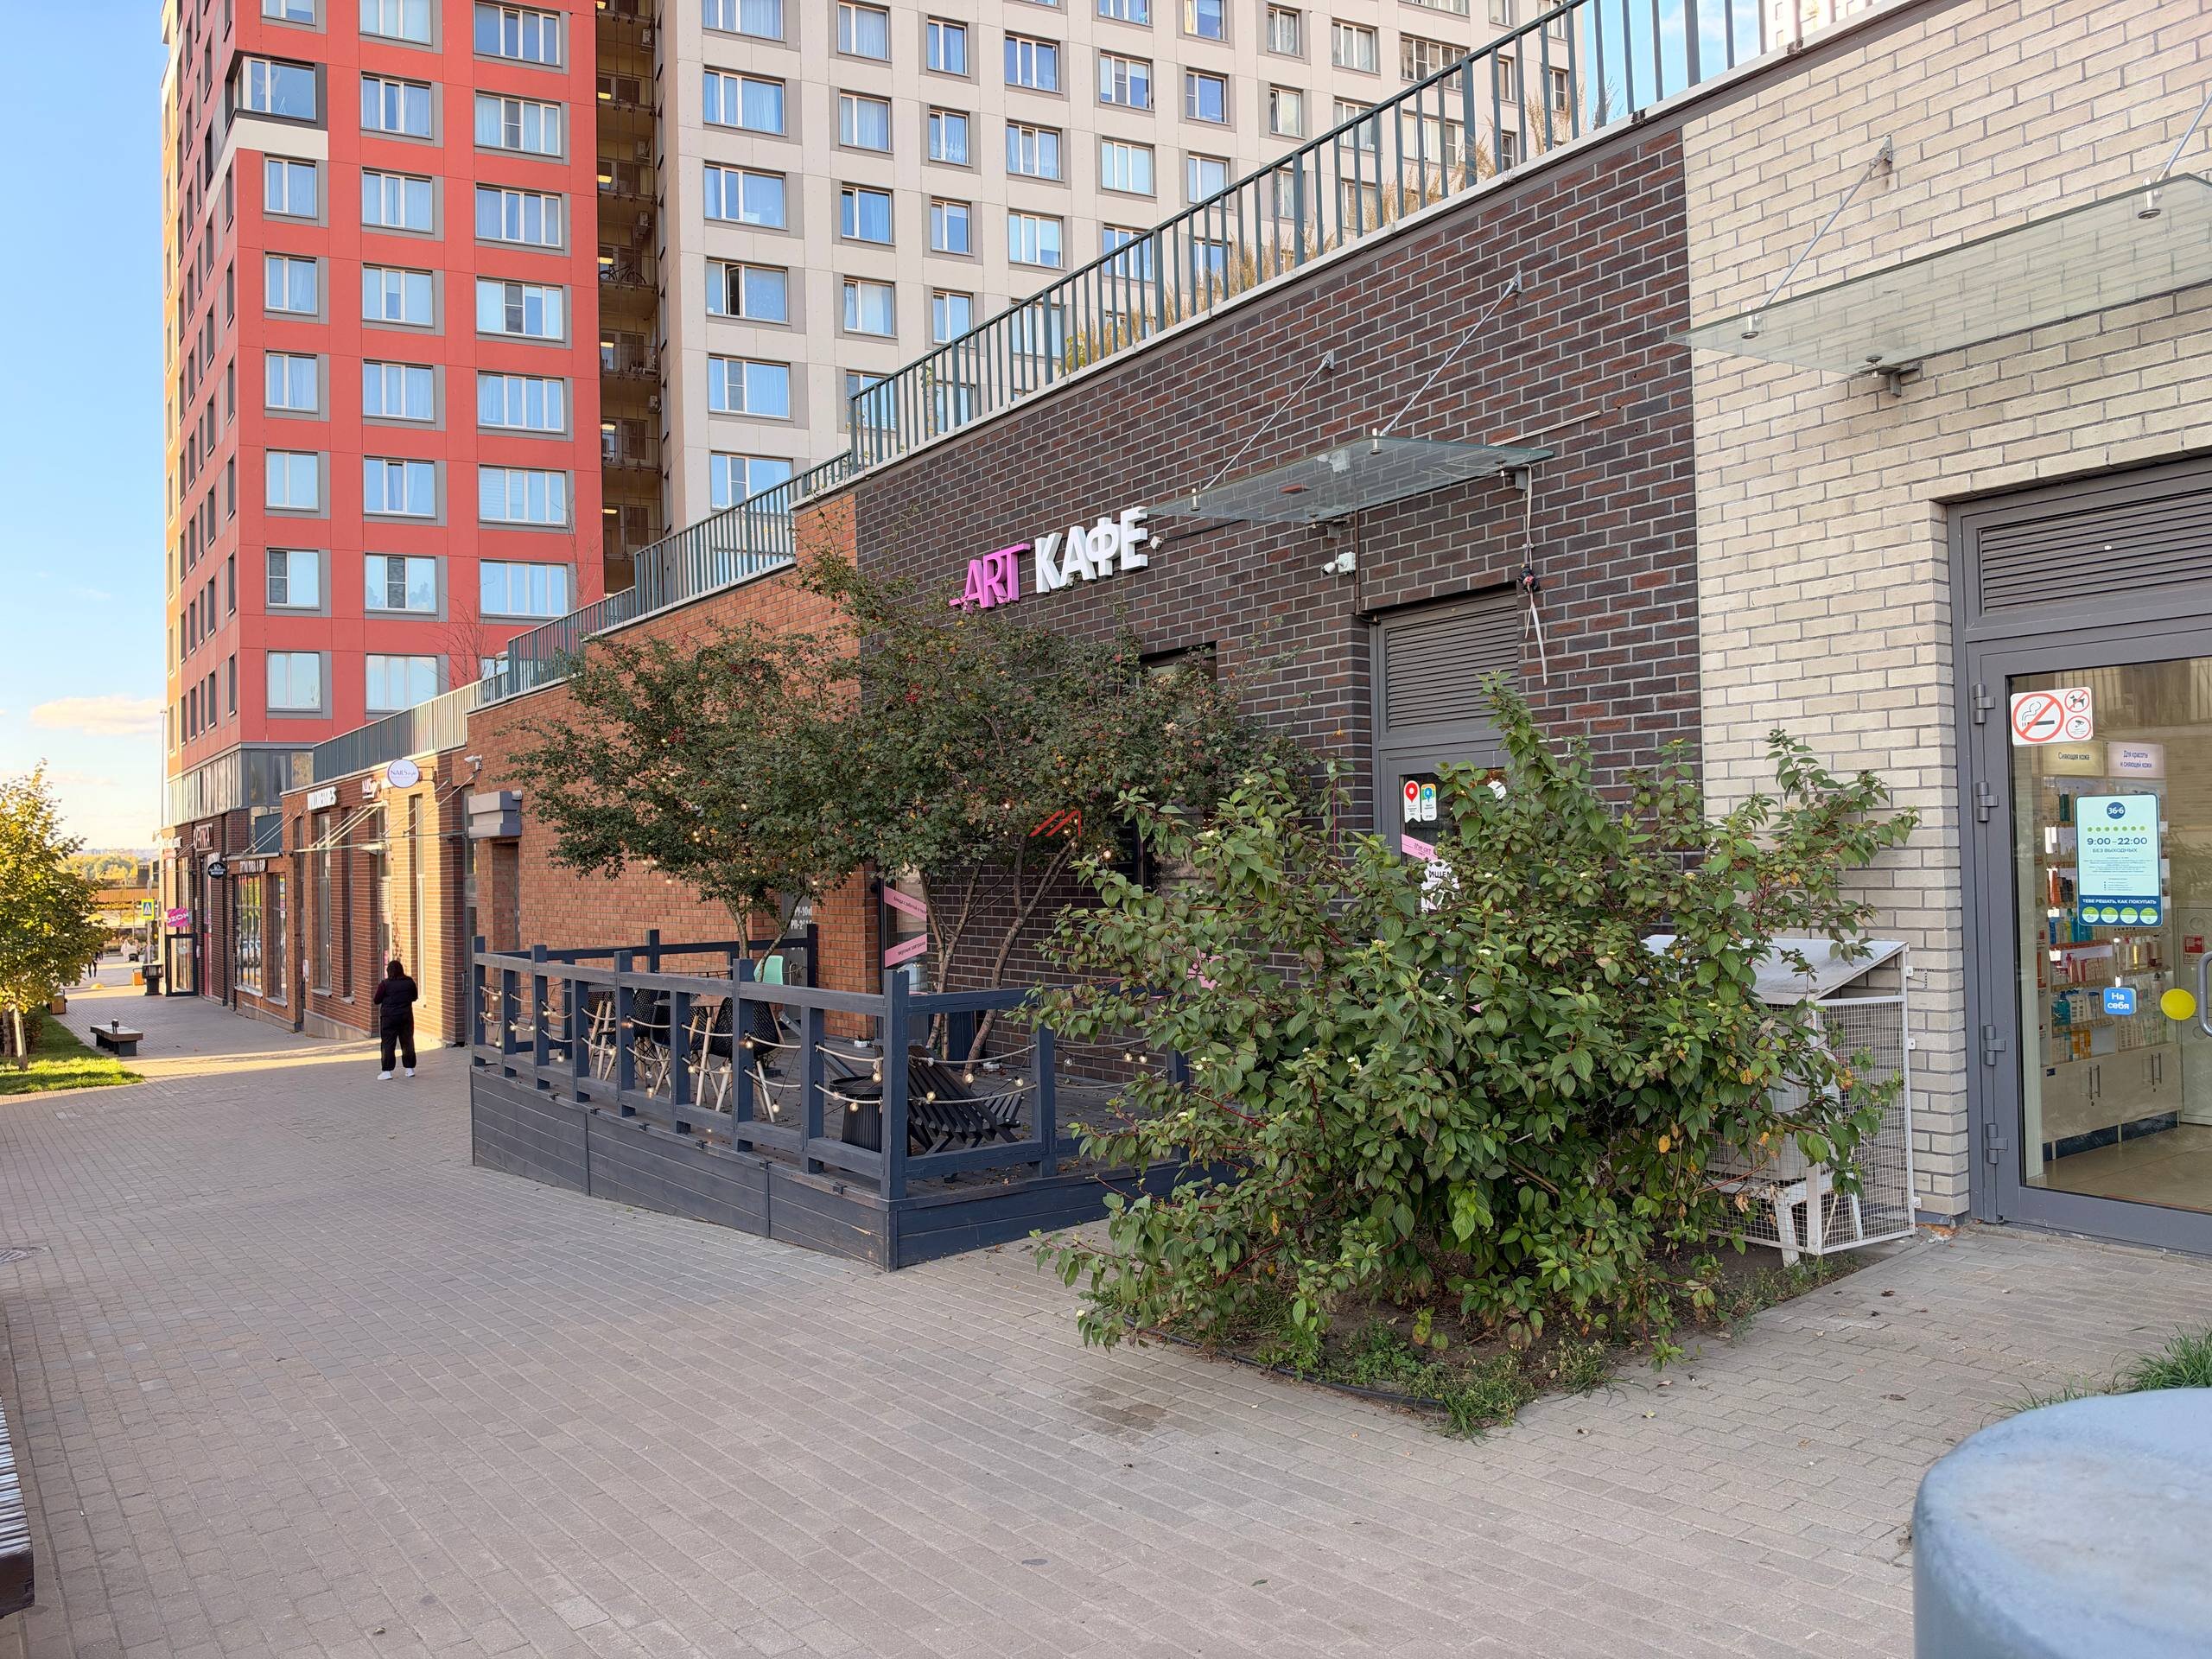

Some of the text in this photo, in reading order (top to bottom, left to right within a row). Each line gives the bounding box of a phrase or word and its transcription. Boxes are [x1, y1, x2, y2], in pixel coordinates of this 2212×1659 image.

[949, 506, 1148, 612] ART КАФЕ
[2111, 992, 2125, 1001] На
[2107, 1001, 2130, 1010] себя
